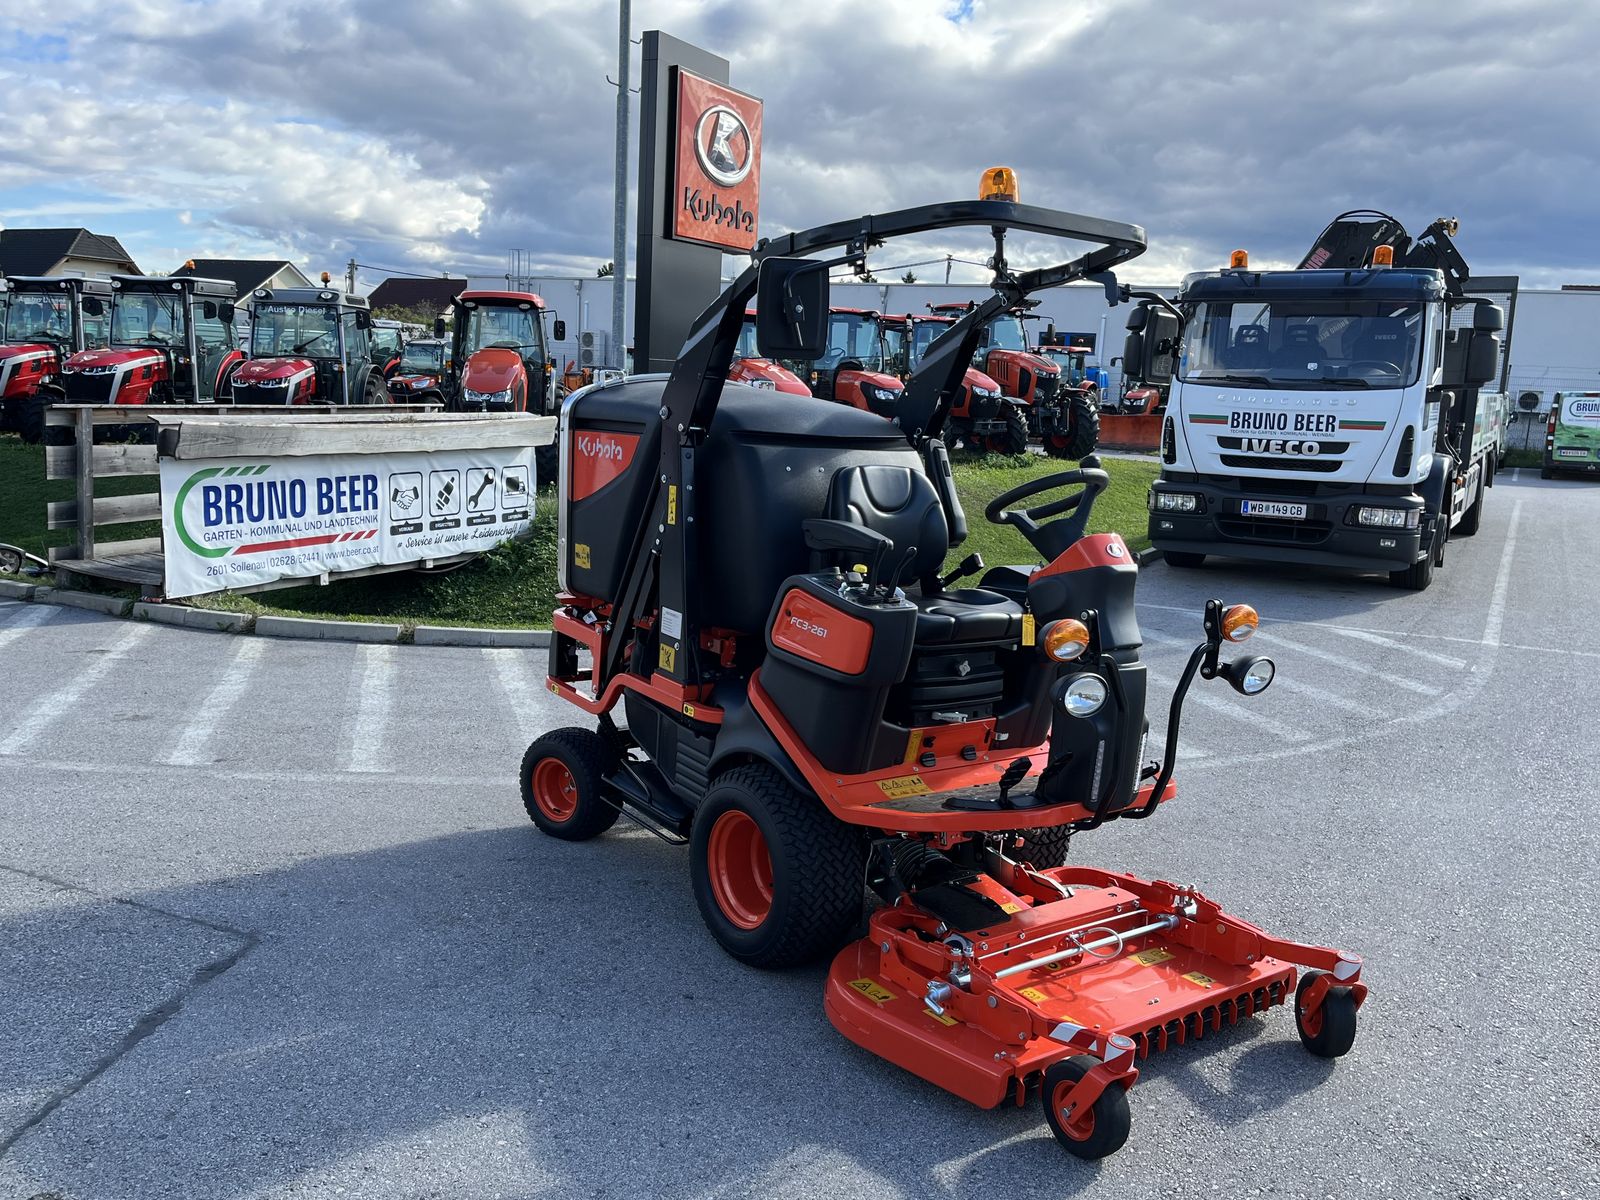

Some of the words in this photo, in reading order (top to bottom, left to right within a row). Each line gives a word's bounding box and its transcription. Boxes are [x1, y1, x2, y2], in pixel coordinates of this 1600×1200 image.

[684, 186, 754, 233] Kubota
[267, 305, 296, 313] Austro
[298, 306, 326, 314] Diesel
[1230, 411, 1288, 431] BRUNO
[1294, 413, 1337, 432] BEER
[578, 436, 623, 461] Kubota
[1241, 438, 1320, 456] IVECO
[202, 478, 306, 527] BRUNO
[316, 474, 379, 516] BEER
[1250, 503, 1264, 513] WB
[1271, 504, 1288, 515] 149
[1290, 505, 1303, 516] CB
[203, 527, 243, 542] GARTEN
[250, 522, 303, 537] KOMMUNAL
[304, 520, 323, 531] UND
[324, 514, 379, 529] LANDTECHNIK
[405, 534, 433, 548] Service
[434, 533, 442, 544] ist
[444, 532, 469, 543] unsere
[206, 565, 228, 577] 2601
[230, 560, 266, 573] Sollenau
[269, 551, 320, 568] 02628/62441
[324, 545, 379, 560] www.beer.co.at
[790, 616, 828, 638] FC3-261
